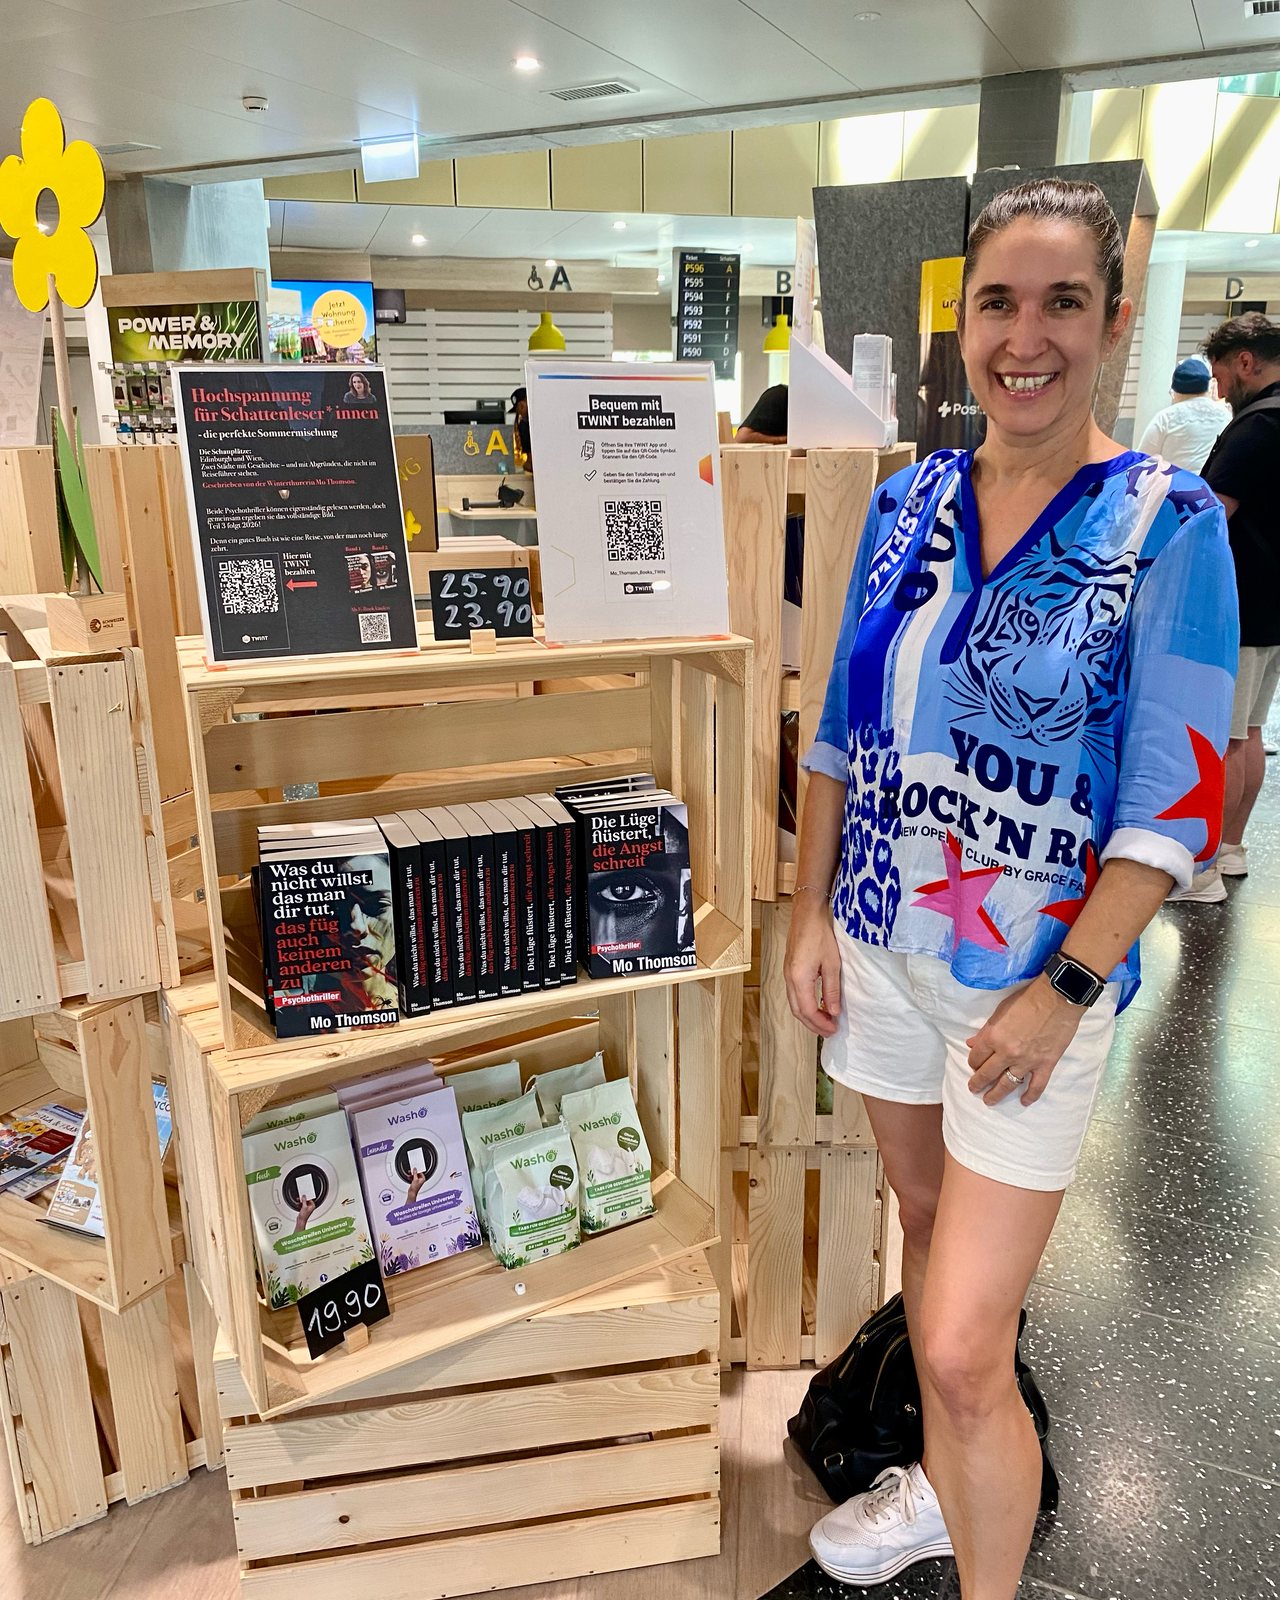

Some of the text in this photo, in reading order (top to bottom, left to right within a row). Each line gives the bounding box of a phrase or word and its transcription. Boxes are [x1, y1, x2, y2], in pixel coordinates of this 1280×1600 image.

[685, 264, 733, 273] P596 A
[550, 266, 573, 291] A
[684, 278, 704, 287] P595
[777, 271, 791, 294] B
[1226, 277, 1244, 300] D
[684, 292, 730, 301] P594 F
[684, 306, 730, 315] P593 F
[118, 315, 216, 334] POWER &
[683, 320, 702, 329] P592
[148, 332, 247, 350] MEMORY
[683, 334, 729, 343] P591 F
[683, 347, 729, 357] P590 D
[723, 361, 728, 369] F
[191, 387, 312, 406] Hochspannung
[591, 399, 660, 412] Bequem mit
[194, 408, 218, 422] für
[579, 415, 673, 427] TWINT bezahlen
[203, 428, 338, 441] die perfekte Sommermischung
[485, 430, 509, 456] A
[207, 516, 241, 524] gemeinsam
[242, 514, 266, 522] ergeben
[224, 507, 265, 516] Psychothriller
[227, 522, 241, 531] folgt
[242, 521, 262, 529] 2026!
[239, 537, 255, 545] gutes
[282, 552, 298, 560] Hier
[283, 560, 310, 568] TWINT
[284, 568, 315, 576] bezahlen
[439, 573, 529, 598] 25.90
[445, 600, 531, 628] 23.90
[950, 727, 1093, 821] YOU &
[591, 813, 656, 830] Die Lüge
[592, 828, 652, 844] flüstert,
[593, 839, 663, 857] die Angst
[270, 862, 334, 877] Was du
[593, 856, 646, 871] schreit
[271, 873, 373, 892] nicht willst,
[1004, 864, 1022, 879] BY
[1024, 870, 1068, 888] GRACE
[272, 891, 345, 905] das man
[274, 904, 335, 919] dir tut,
[275, 918, 339, 935] das füg
[277, 934, 319, 949] auch
[564, 929, 573, 949] Lüge
[278, 946, 341, 963] keinem
[597, 942, 641, 953] Psychothriller
[280, 960, 351, 976] anderen
[613, 954, 697, 973] Mo Thomson
[280, 978, 300, 989] zu
[282, 991, 340, 1005] Psychothriller
[310, 1010, 397, 1029] Mo Thomson
[282, 1221, 348, 1247] Waschstreifen Universal
[308, 1283, 381, 1338] 19.90
